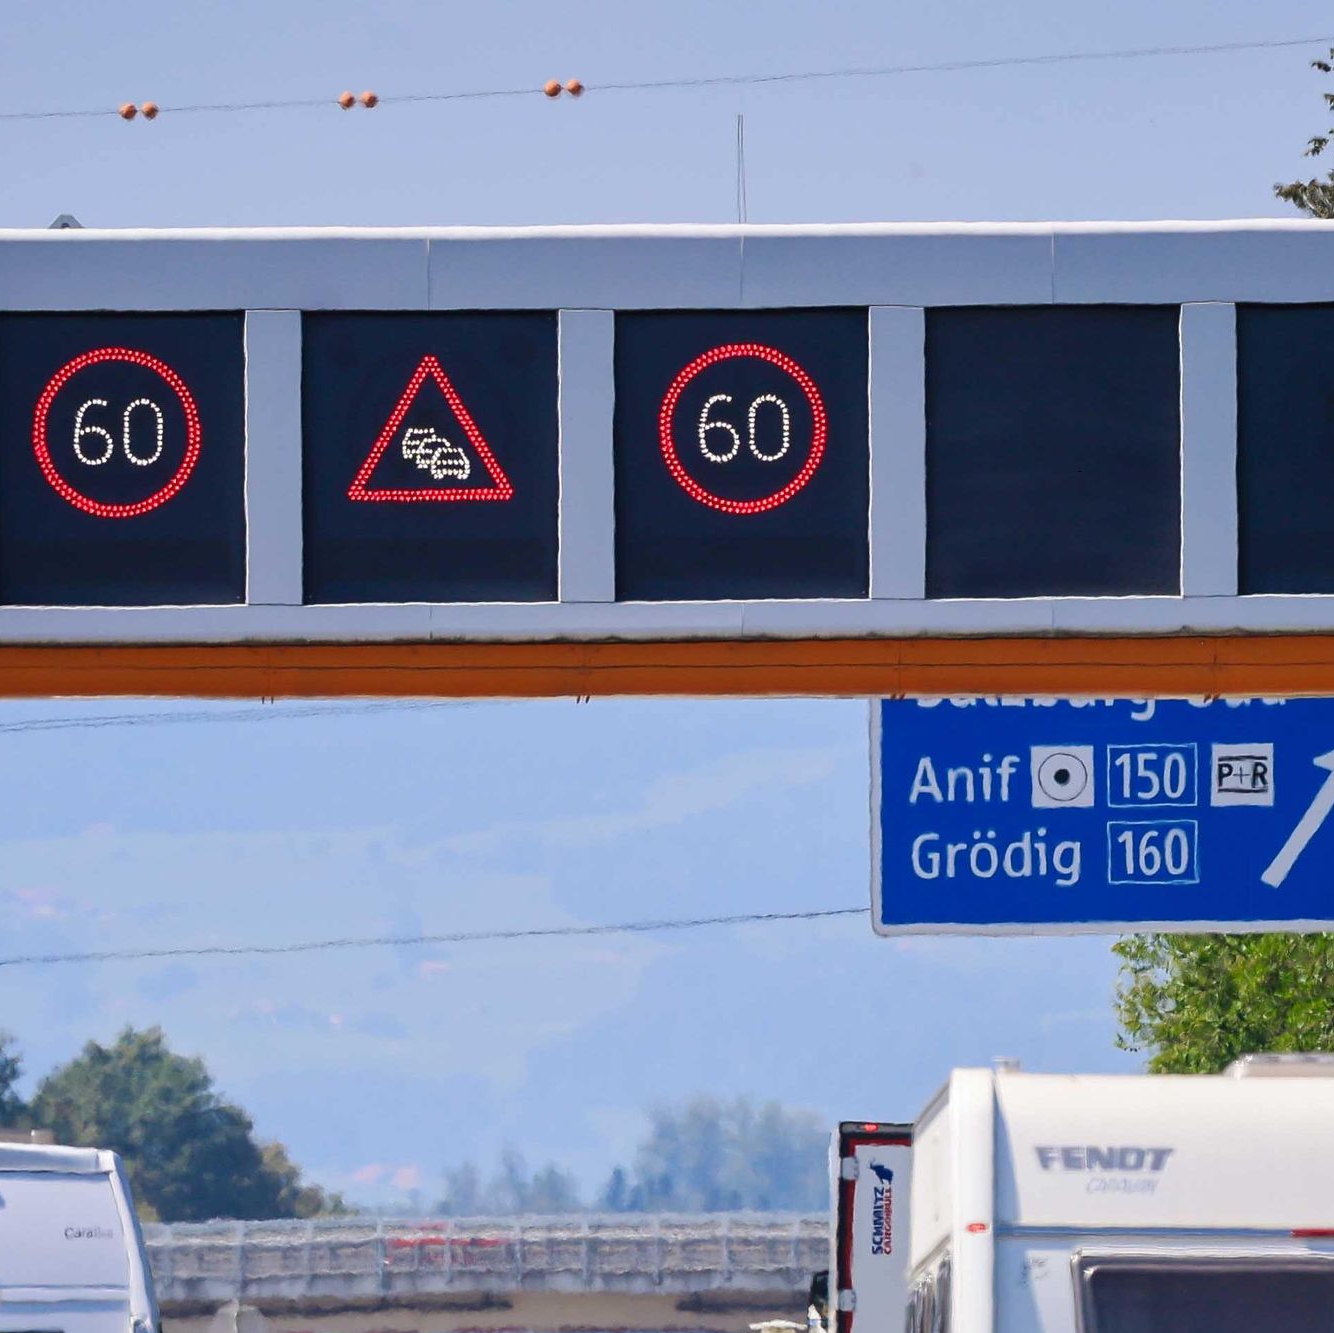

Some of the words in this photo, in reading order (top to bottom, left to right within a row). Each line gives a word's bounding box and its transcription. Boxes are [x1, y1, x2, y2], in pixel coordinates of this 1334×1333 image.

[73, 398, 164, 466] 60
[697, 393, 790, 462] 60
[909, 752, 1021, 803] Anif
[1115, 752, 1186, 800] 150
[1217, 761, 1268, 787] P+R
[911, 828, 1082, 887] Grödig
[1118, 829, 1189, 877] 160
[1034, 1145, 1175, 1171] FENDT
